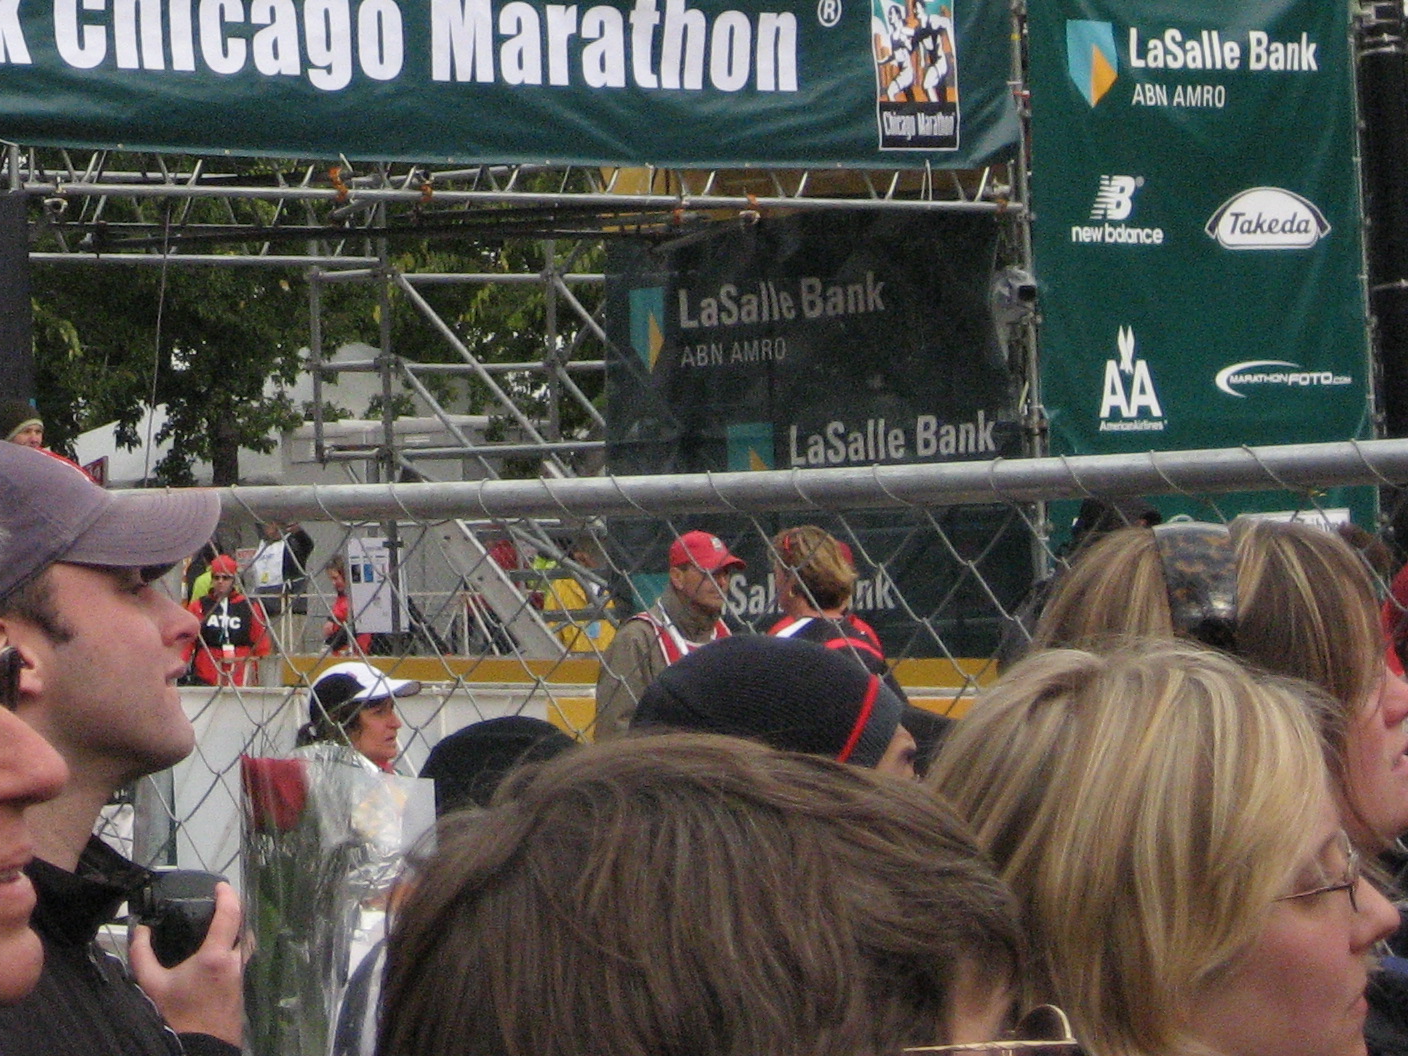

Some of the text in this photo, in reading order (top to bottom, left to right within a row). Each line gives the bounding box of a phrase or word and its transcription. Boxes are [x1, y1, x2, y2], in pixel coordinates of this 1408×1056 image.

[1129, 27, 1318, 71] LaSalle Bank
[1131, 83, 1226, 108] ABN AMRO
[883, 111, 955, 140] Chicago Marathon
[1228, 212, 1311, 236] Takeda
[678, 270, 885, 328] LaSalle Bank
[680, 337, 787, 368] ABN AMRO
[790, 410, 996, 465] LaSalle Bank
[206, 614, 242, 630] ATC
